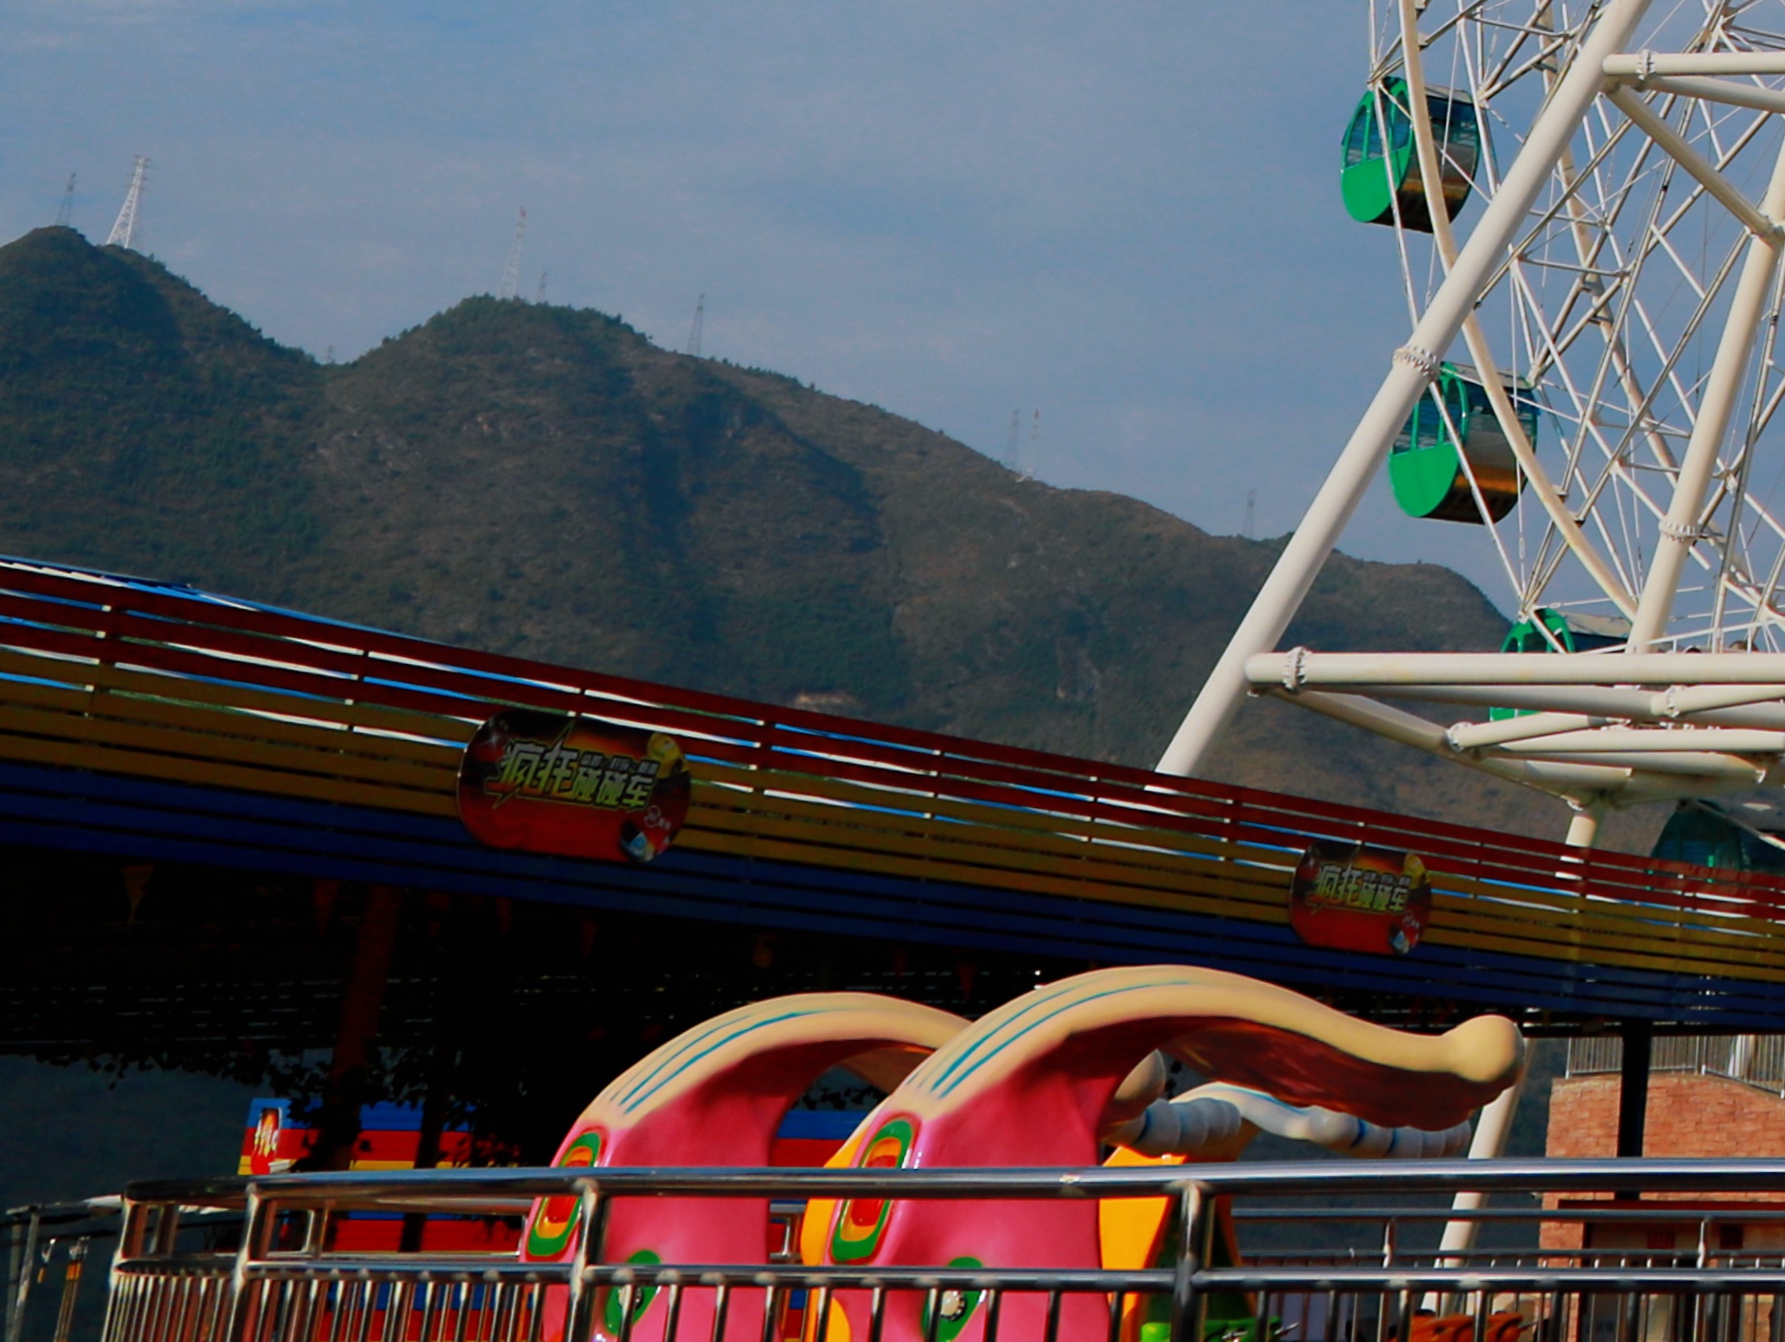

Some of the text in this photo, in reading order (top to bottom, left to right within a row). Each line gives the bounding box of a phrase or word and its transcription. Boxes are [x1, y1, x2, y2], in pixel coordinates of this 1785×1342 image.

[499, 736, 654, 809] 疯狂碰碰车
